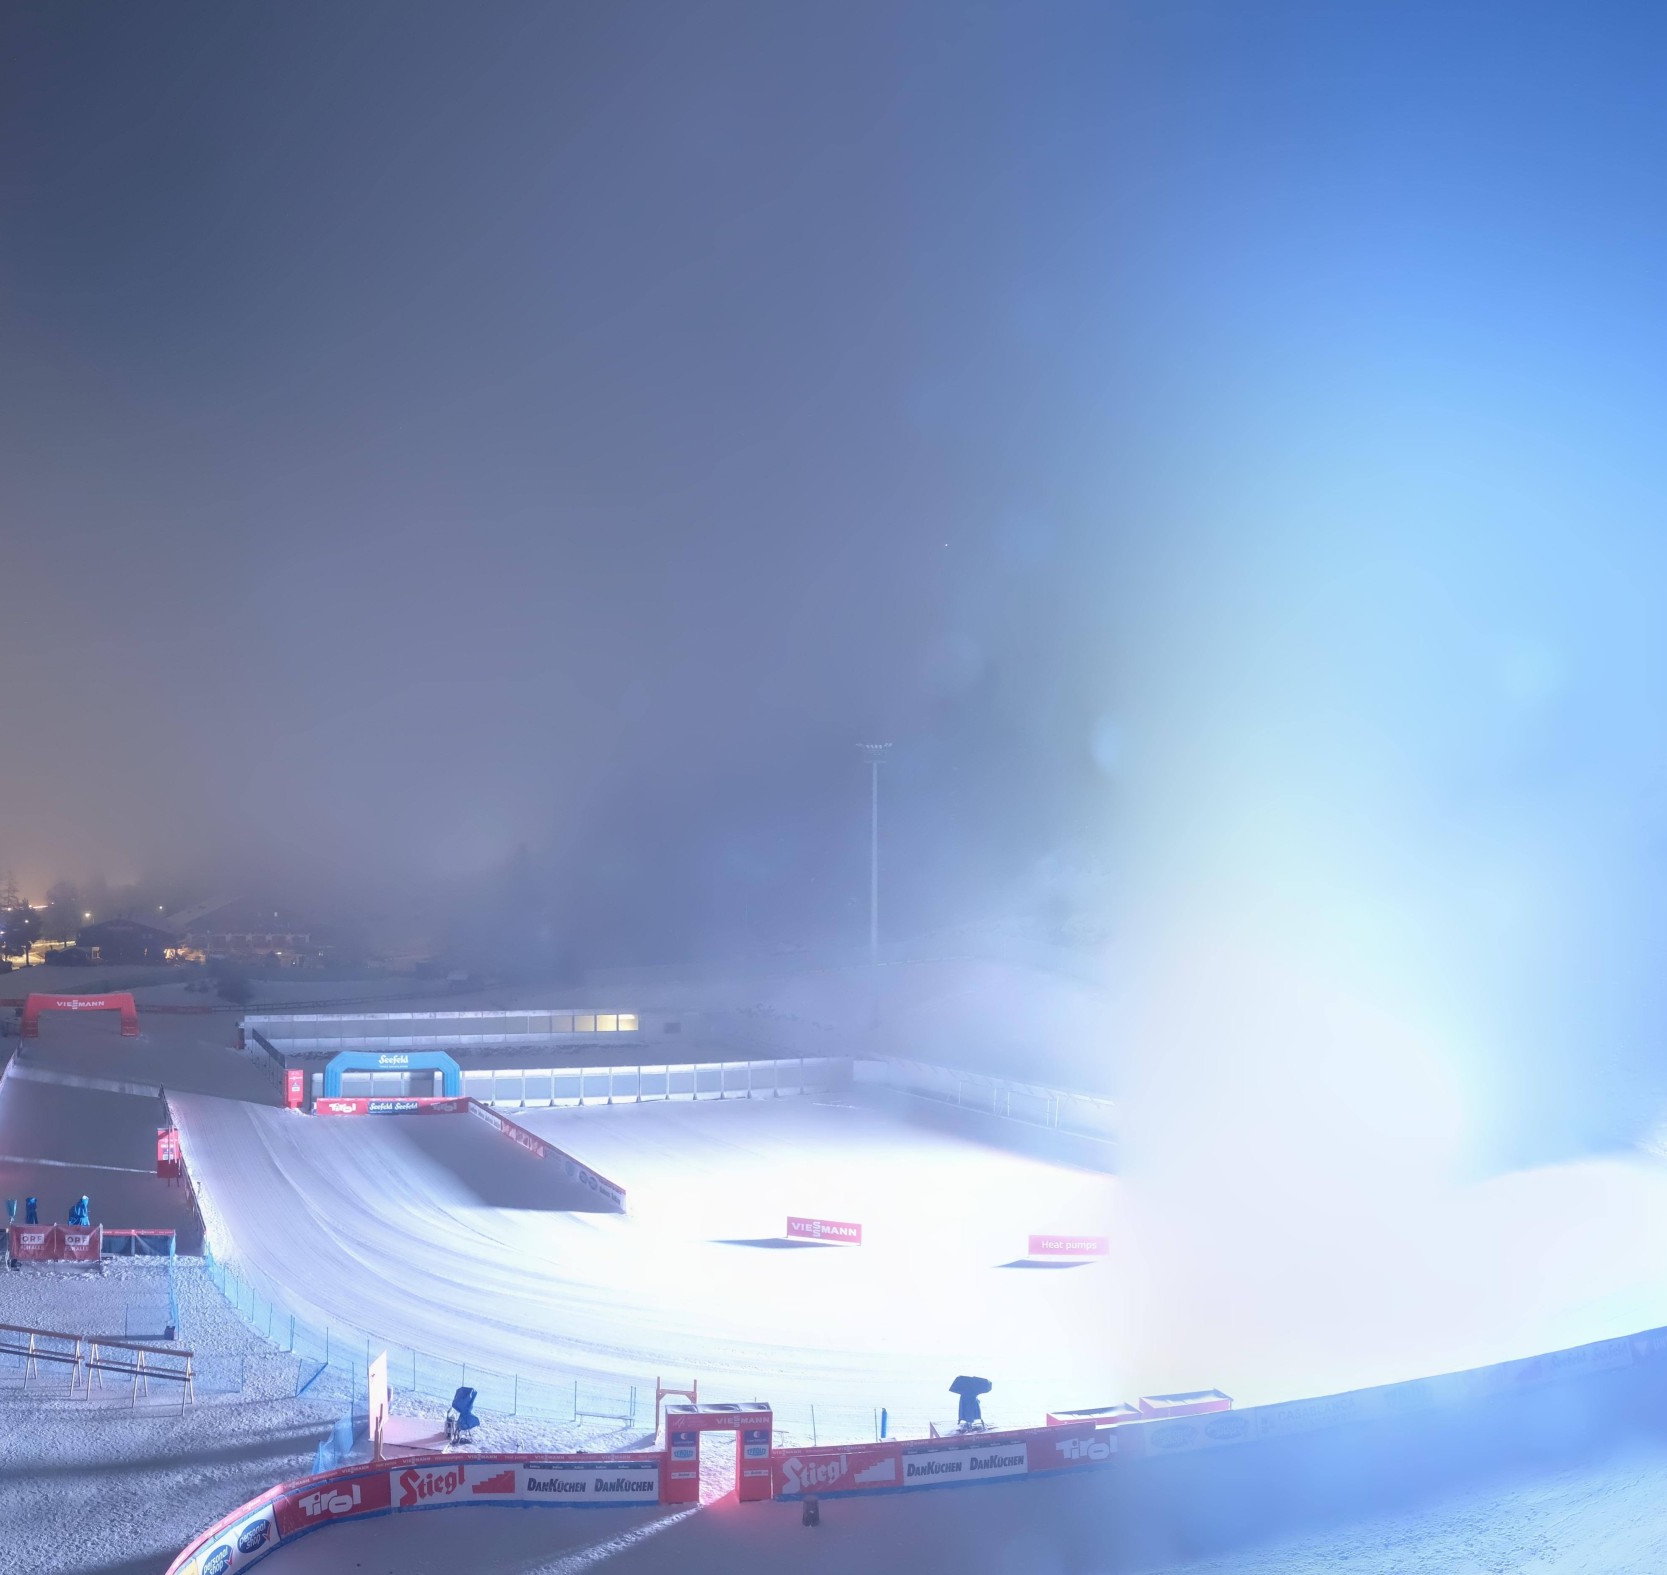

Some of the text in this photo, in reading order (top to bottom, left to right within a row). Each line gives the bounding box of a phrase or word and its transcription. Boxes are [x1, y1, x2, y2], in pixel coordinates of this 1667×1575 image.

[56, 999, 105, 1010] VIESSMANN
[378, 1054, 409, 1065] Seefeld
[328, 1103, 356, 1112] Tirol
[369, 1102, 418, 1111] Seefeld Seefeld
[791, 1221, 857, 1237] VIESSMANN
[22, 1235, 43, 1243] ORF
[1041, 1240, 1097, 1251] Heat pumps
[716, 1415, 770, 1428] VIESSMANN
[773, 1449, 802, 1457] VIESSMANN
[901, 1440, 929, 1448] VIESSMANN
[1055, 1434, 1118, 1460] Tirol
[341, 1465, 370, 1474] VIESSMANN
[403, 1456, 431, 1465] VIESSMANN
[781, 1454, 848, 1495] Stiegl
[400, 1464, 466, 1507] Stiegl
[298, 1484, 362, 1517] Tirol
[238, 1521, 267, 1547] personal
[245, 1535, 262, 1551] shop
[203, 1548, 229, 1574] personal
[209, 1561, 224, 1575] shop
